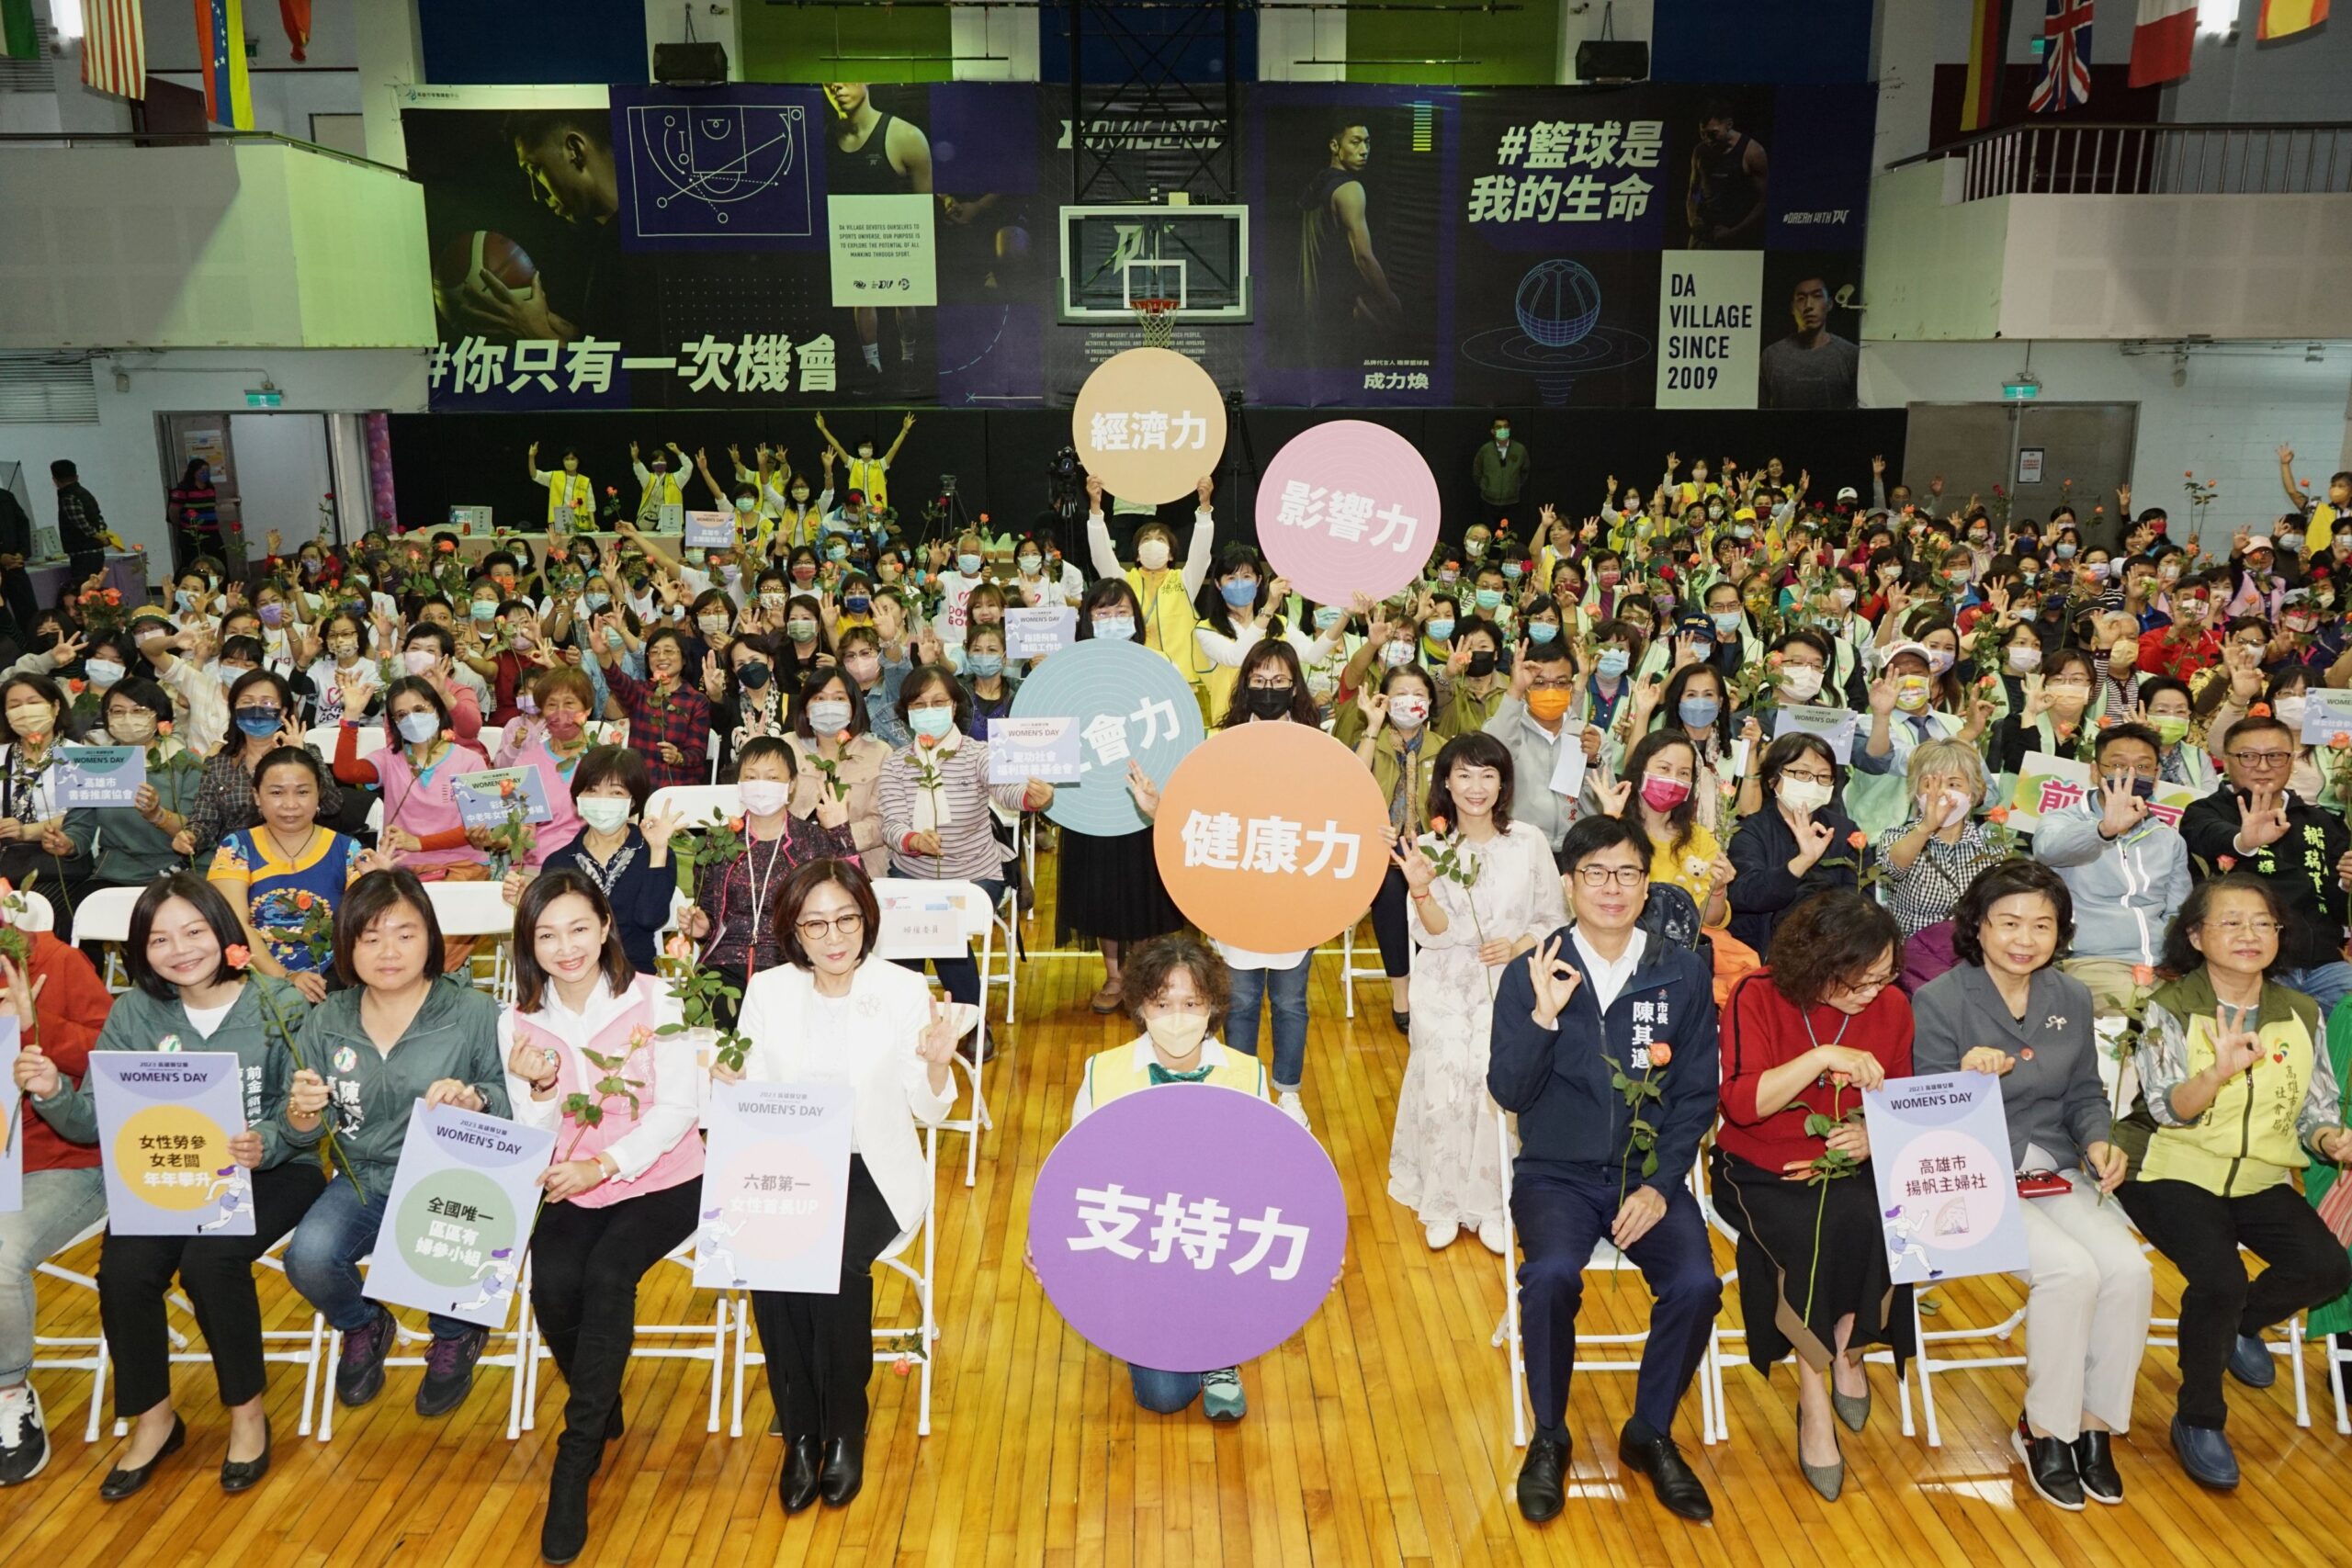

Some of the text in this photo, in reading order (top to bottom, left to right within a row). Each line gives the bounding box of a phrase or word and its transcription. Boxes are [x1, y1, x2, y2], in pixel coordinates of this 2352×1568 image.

[1497, 119, 1664, 170] #籃球是
[1468, 173, 1655, 223] 我的生命
[1670, 274, 1696, 297] DA
[1669, 305, 1752, 329] VILLAGE
[1668, 336, 1729, 359] SINCE
[428, 334, 838, 393] #你只有一次機會
[1363, 372, 1430, 389] 成力煥
[1668, 367, 1719, 390] 2009
[1091, 410, 1208, 452] 經濟力
[1276, 478, 1419, 554] 影響力
[1794, 715, 1824, 723] WOMEN'S
[1180, 808, 1362, 879] 健康力
[1657, 1001, 1668, 1024] 市長
[119, 1072, 208, 1082] WOMEN'S DAY
[738, 1102, 824, 1117] WOMEN'S DAY
[1891, 1092, 1973, 1111] WOMEN'S DAY
[139, 1134, 206, 1149] 女性勞參
[436, 1125, 494, 1148] WOMEN'S
[496, 1141, 522, 1156] DAY
[150, 1153, 200, 1168] 女老闆
[1918, 1155, 1967, 1175] 高雄市
[743, 1173, 811, 1191] 六都第一
[1905, 1173, 1987, 1197] 揚帆主婦社
[426, 1196, 494, 1222] 全國唯一
[428, 1220, 479, 1247] 區區有
[1066, 1182, 1308, 1280] 支持力
